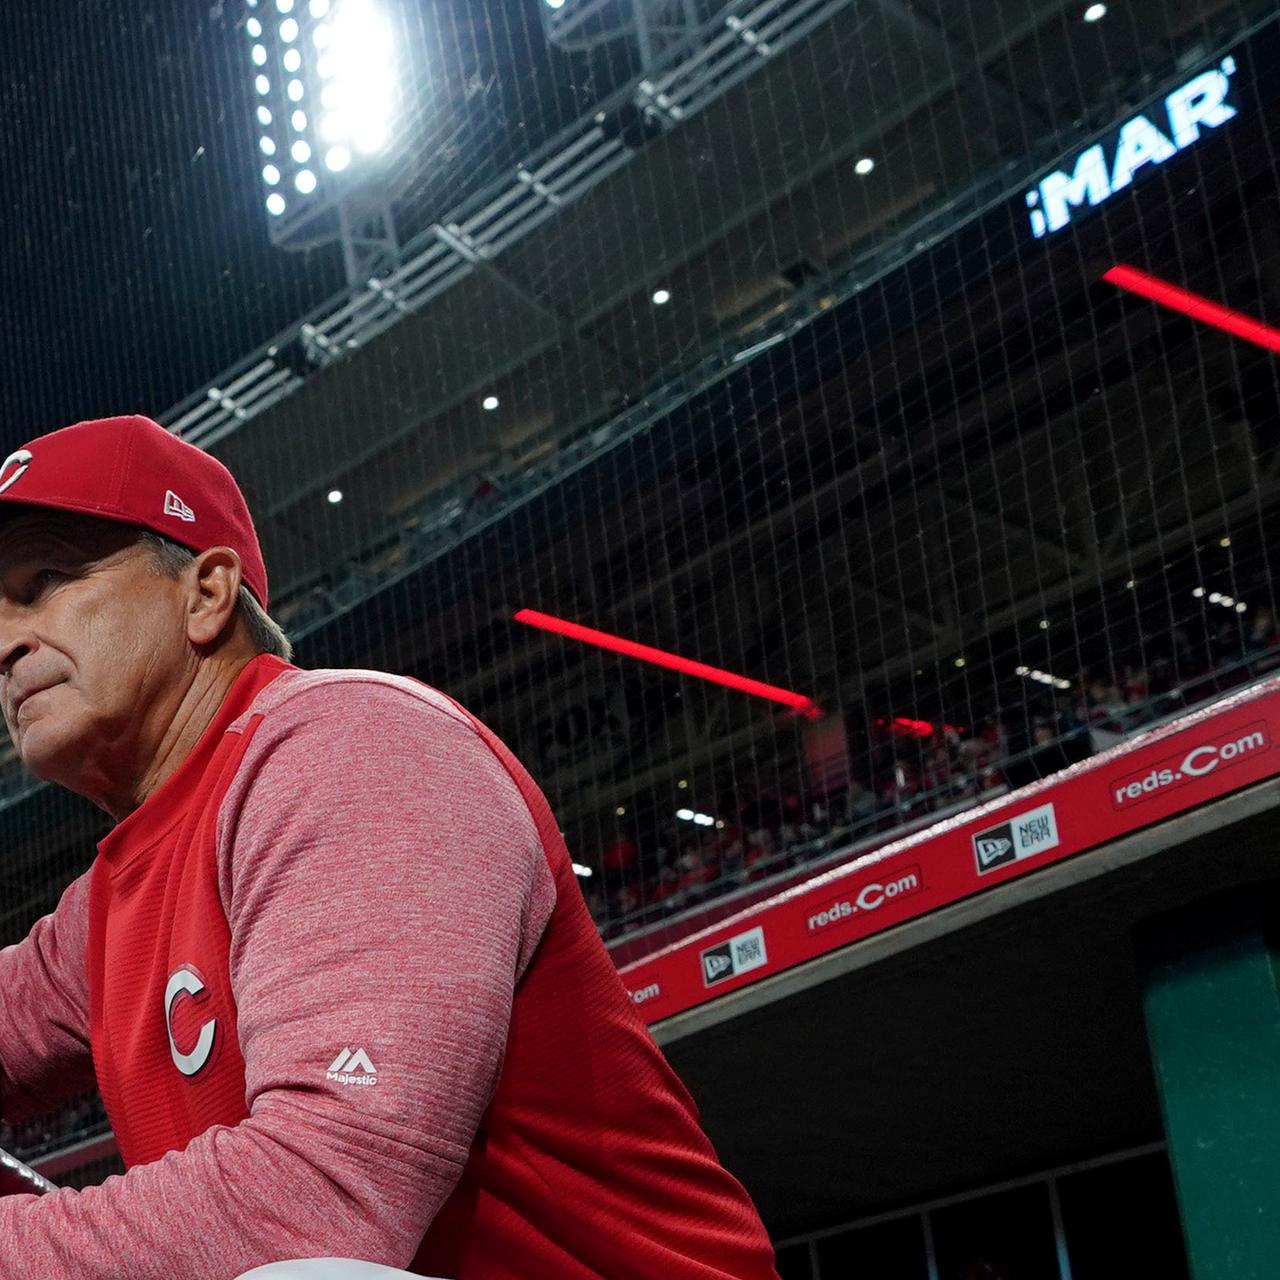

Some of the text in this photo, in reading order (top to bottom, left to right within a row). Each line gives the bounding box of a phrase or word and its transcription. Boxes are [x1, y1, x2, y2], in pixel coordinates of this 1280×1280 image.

[1116, 728, 1264, 803] reds.Com
[1018, 816, 1049, 833] NEW
[1021, 827, 1051, 849] ERA
[808, 870, 918, 930] reds.Com
[164, 967, 218, 1077] C
[326, 1071, 377, 1086] Majestic
